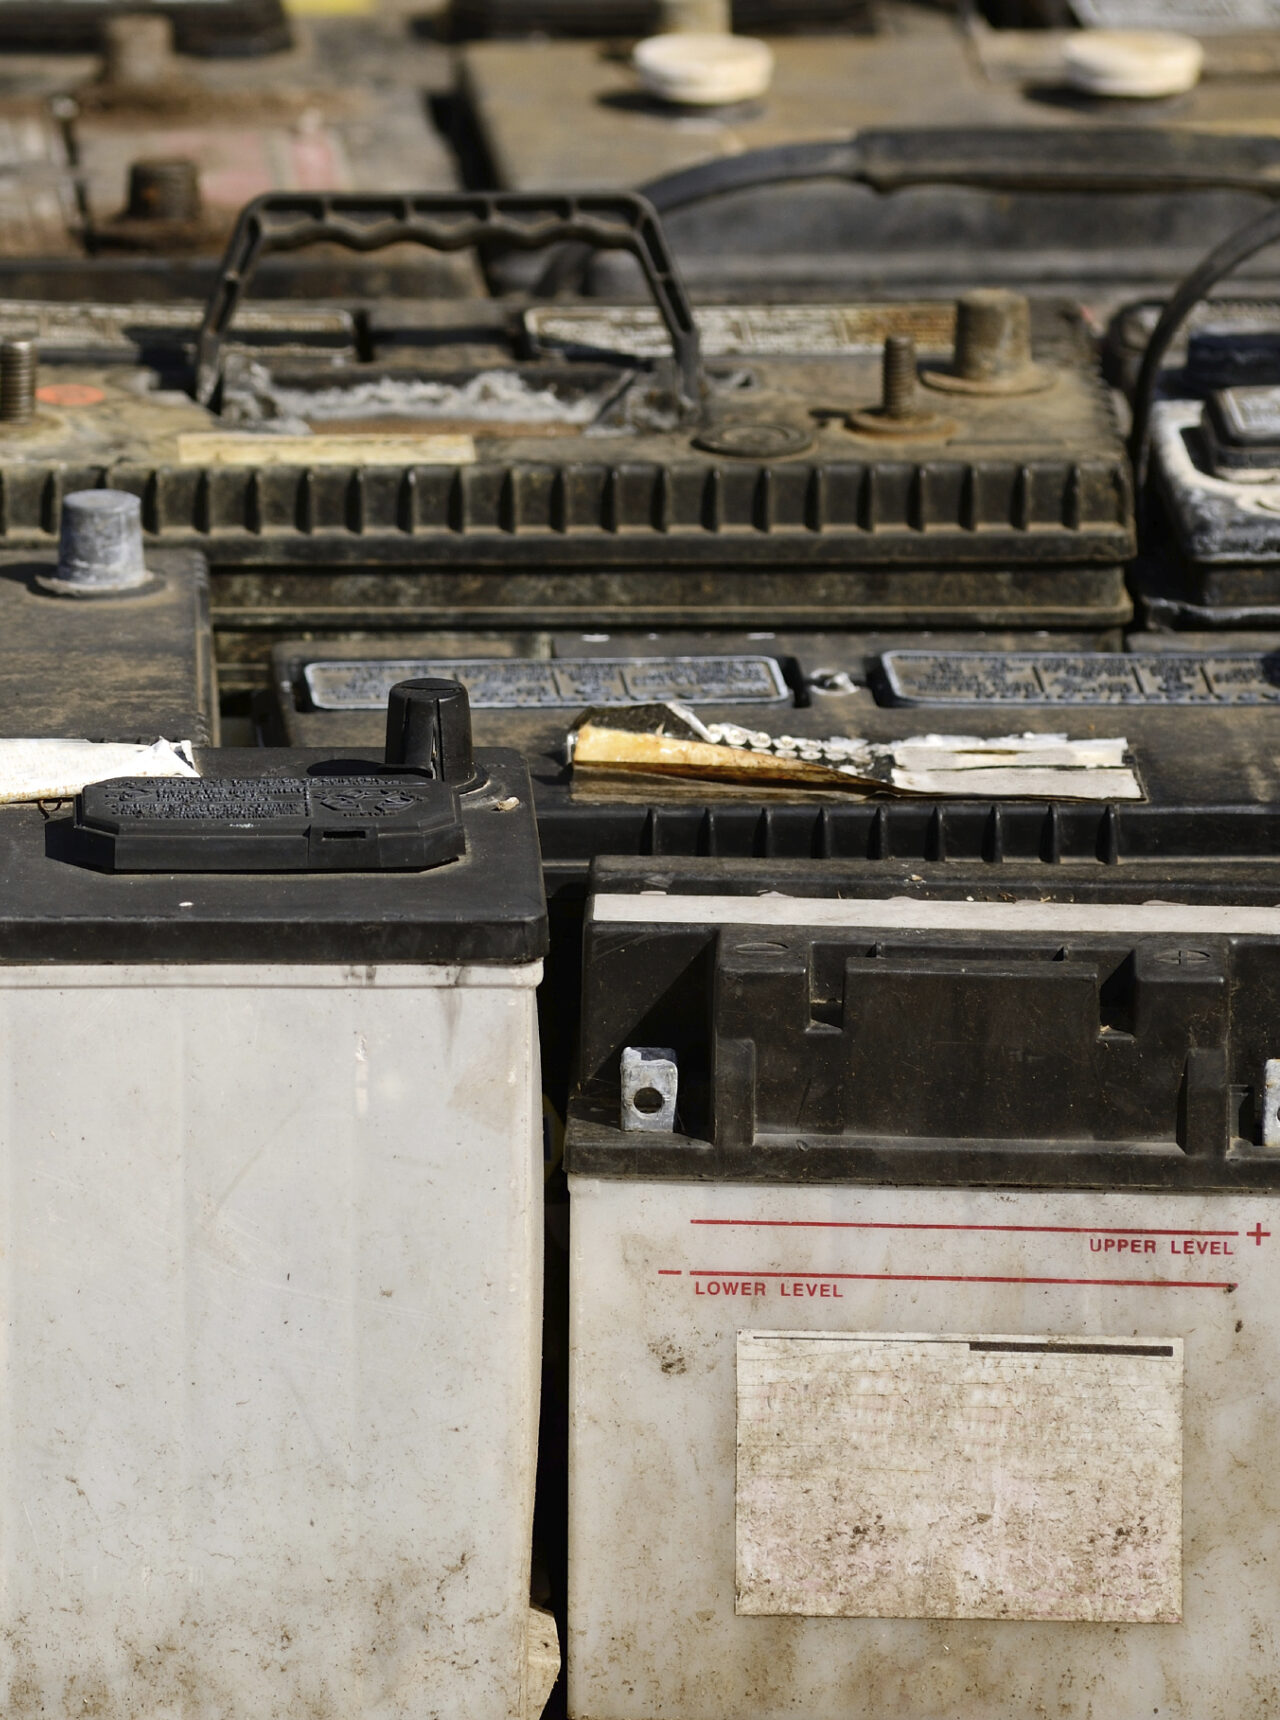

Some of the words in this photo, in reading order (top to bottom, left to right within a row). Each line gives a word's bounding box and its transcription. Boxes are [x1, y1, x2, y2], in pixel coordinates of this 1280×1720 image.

[1089, 1237, 1156, 1254] UPPER
[1170, 1239, 1234, 1256] LEVEL
[695, 1280, 766, 1296] LOWER
[780, 1282, 844, 1298] LEVEL
